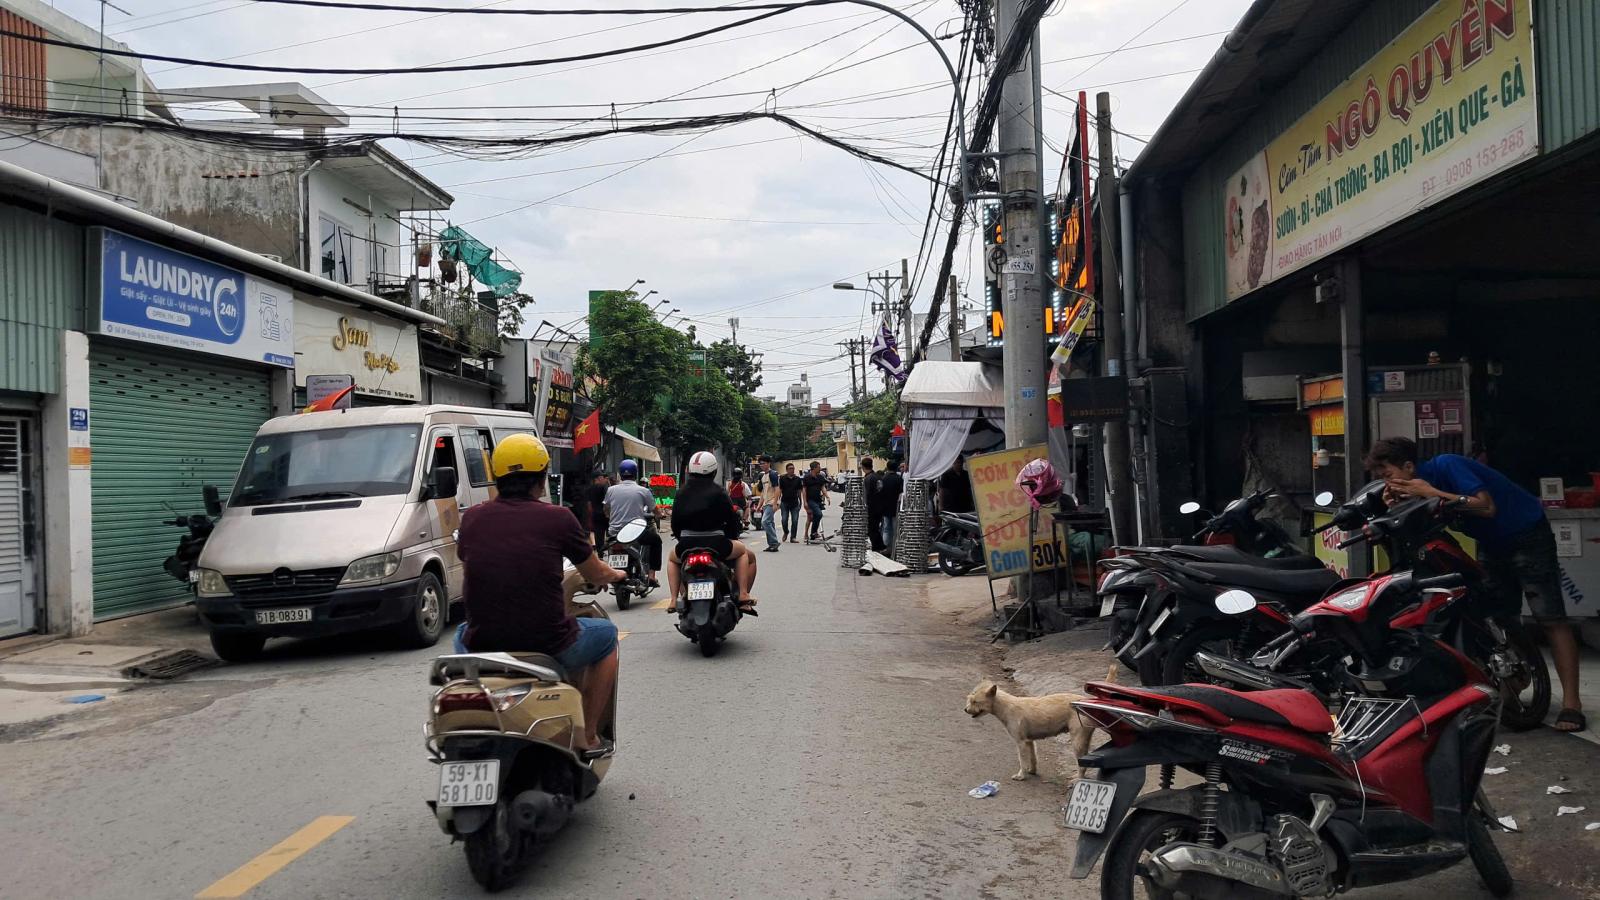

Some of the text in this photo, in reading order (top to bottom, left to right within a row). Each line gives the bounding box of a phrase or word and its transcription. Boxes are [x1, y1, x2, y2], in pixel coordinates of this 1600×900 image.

[1325, 75, 1381, 164] NGÔ
[1276, 203, 1297, 240] SƯỜN
[1315, 177, 1333, 217] CHẢ
[1334, 163, 1368, 206] TRỨNG
[1374, 150, 1390, 184] BA
[1392, 134, 1413, 174] RỌI
[1421, 108, 1454, 156] XIÊN
[1458, 84, 1489, 135] QUE
[120, 250, 215, 303] LAUNDRY
[219, 302, 237, 318] 24h
[72, 409, 86, 421] 29
[986, 490, 1025, 511] NG
[449, 763, 488, 783] 59-X1
[441, 783, 494, 804] 581.00
